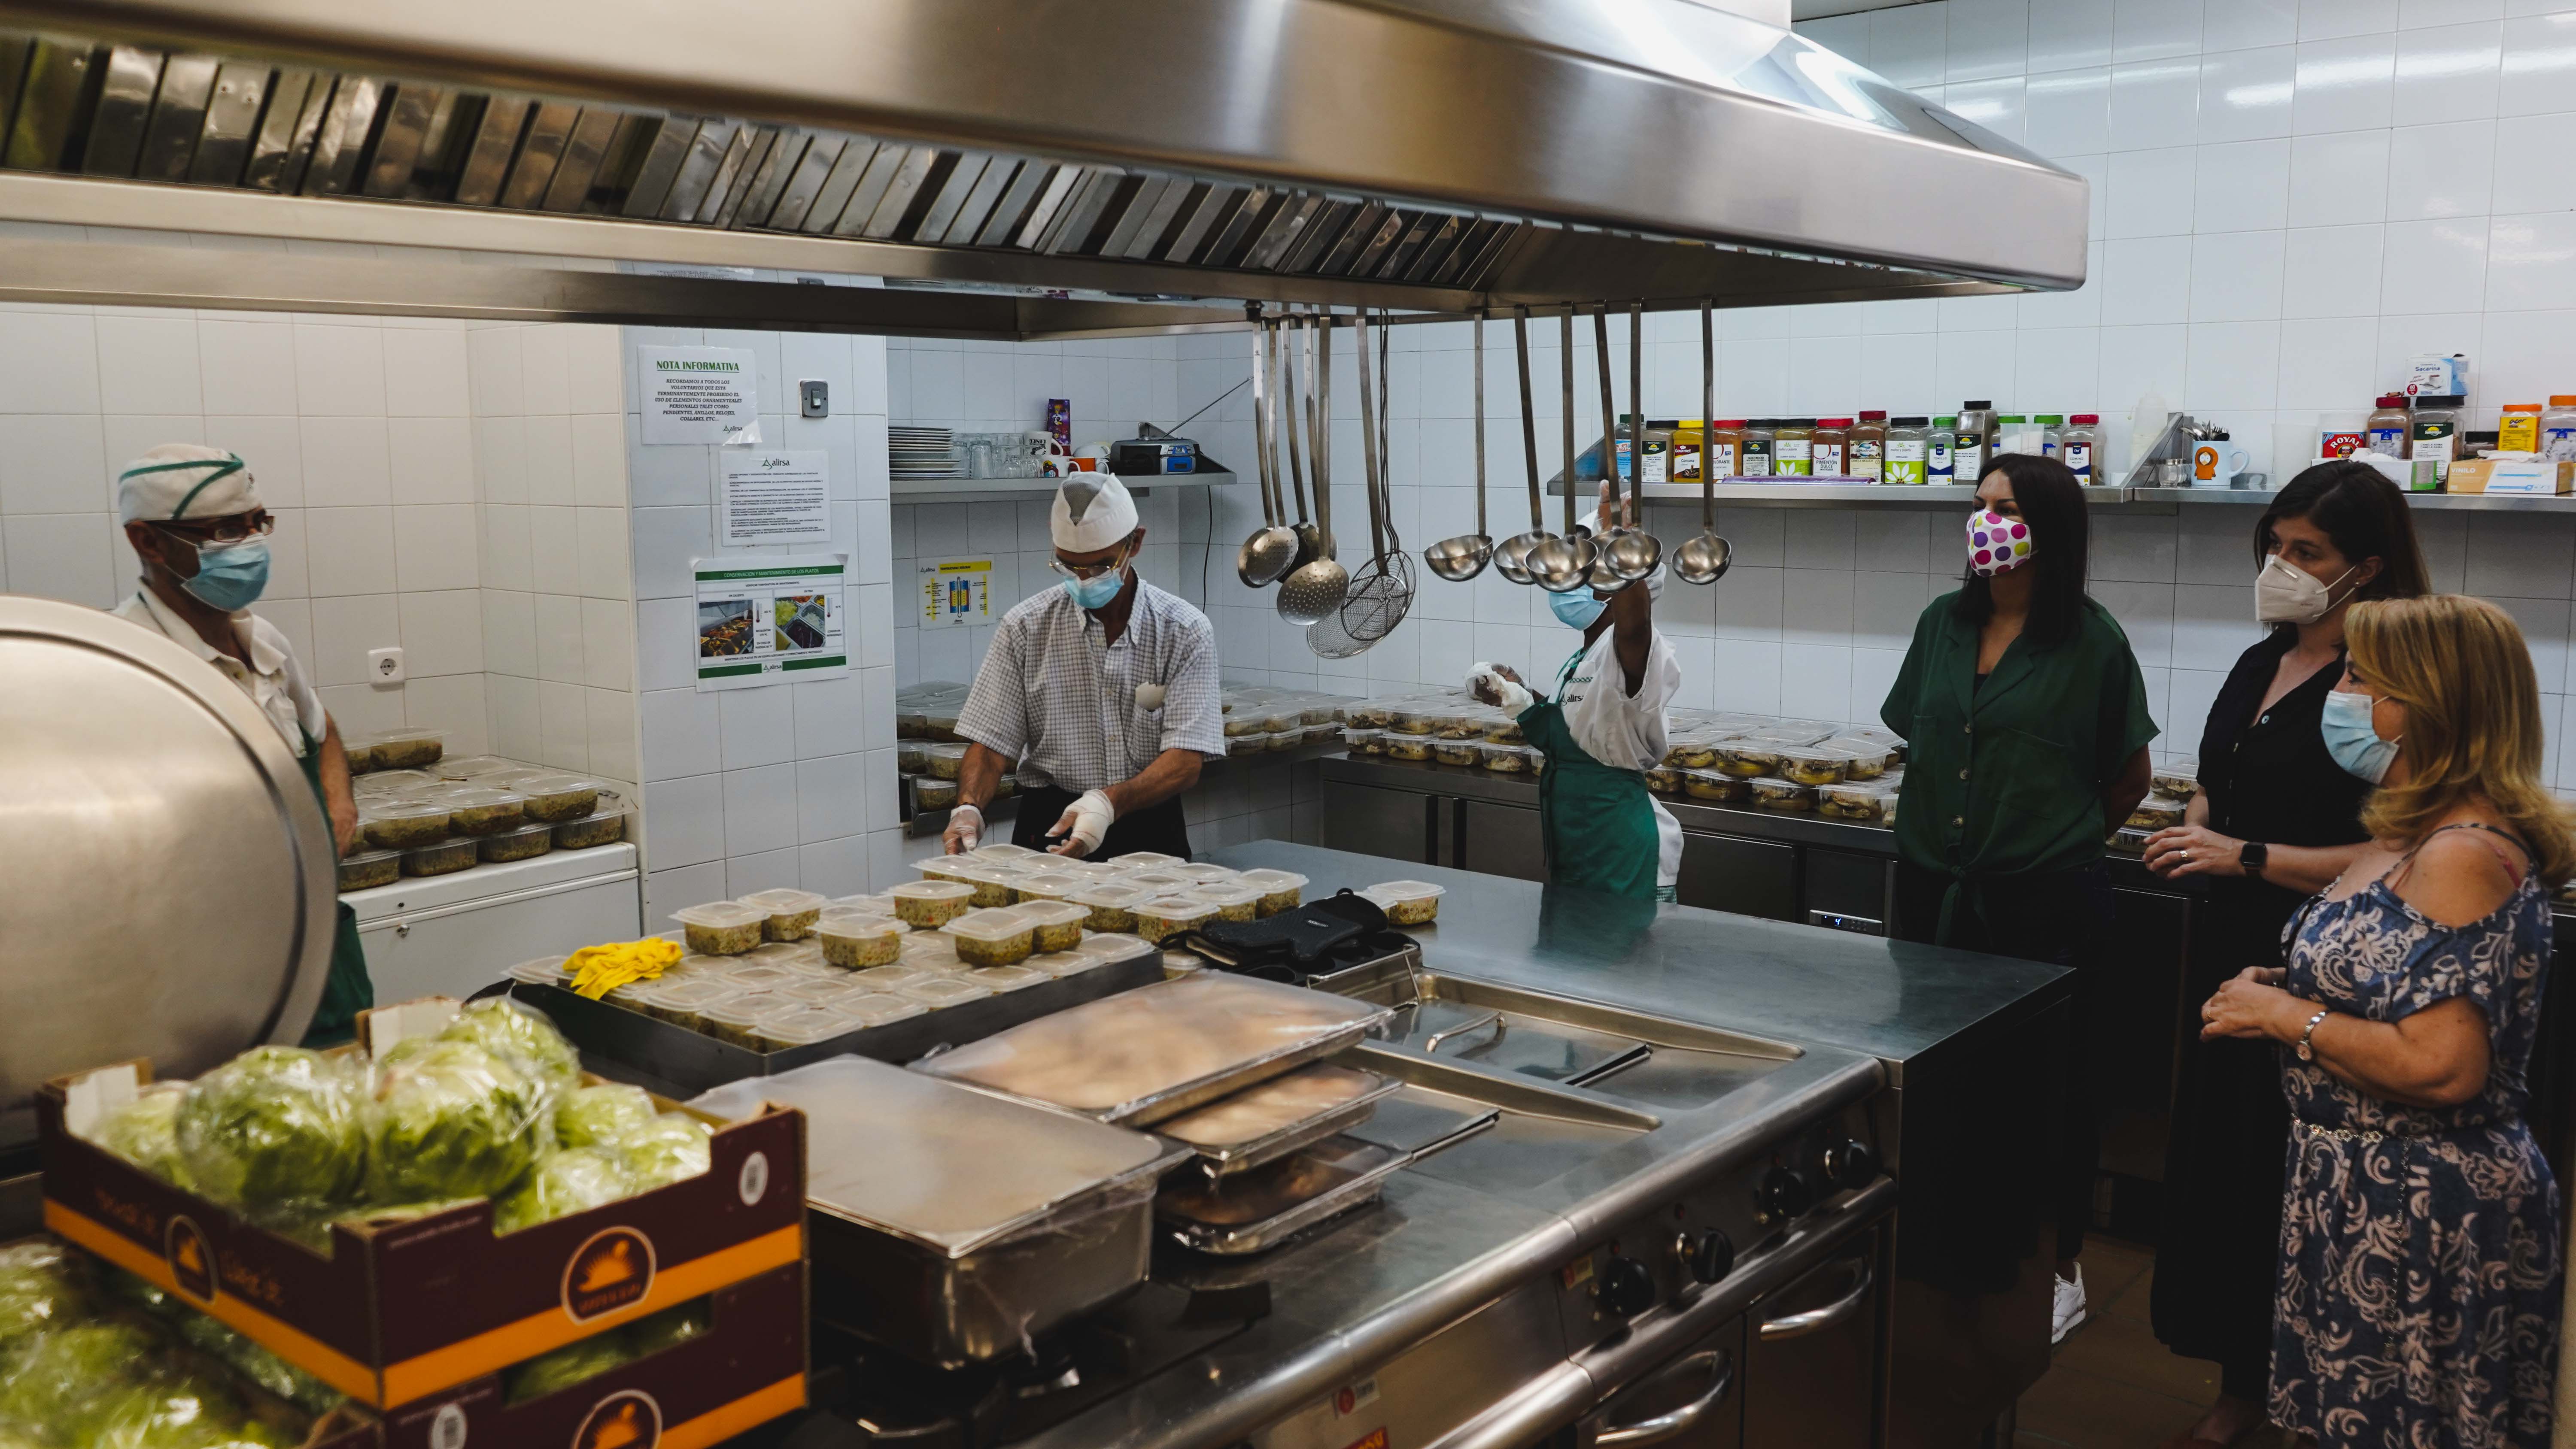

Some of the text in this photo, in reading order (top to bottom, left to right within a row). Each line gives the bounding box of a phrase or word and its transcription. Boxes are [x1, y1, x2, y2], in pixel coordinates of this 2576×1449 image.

[657, 361, 739, 370] NOTA INFORMATIVA
[2330, 436, 2360, 449] ROYAL
